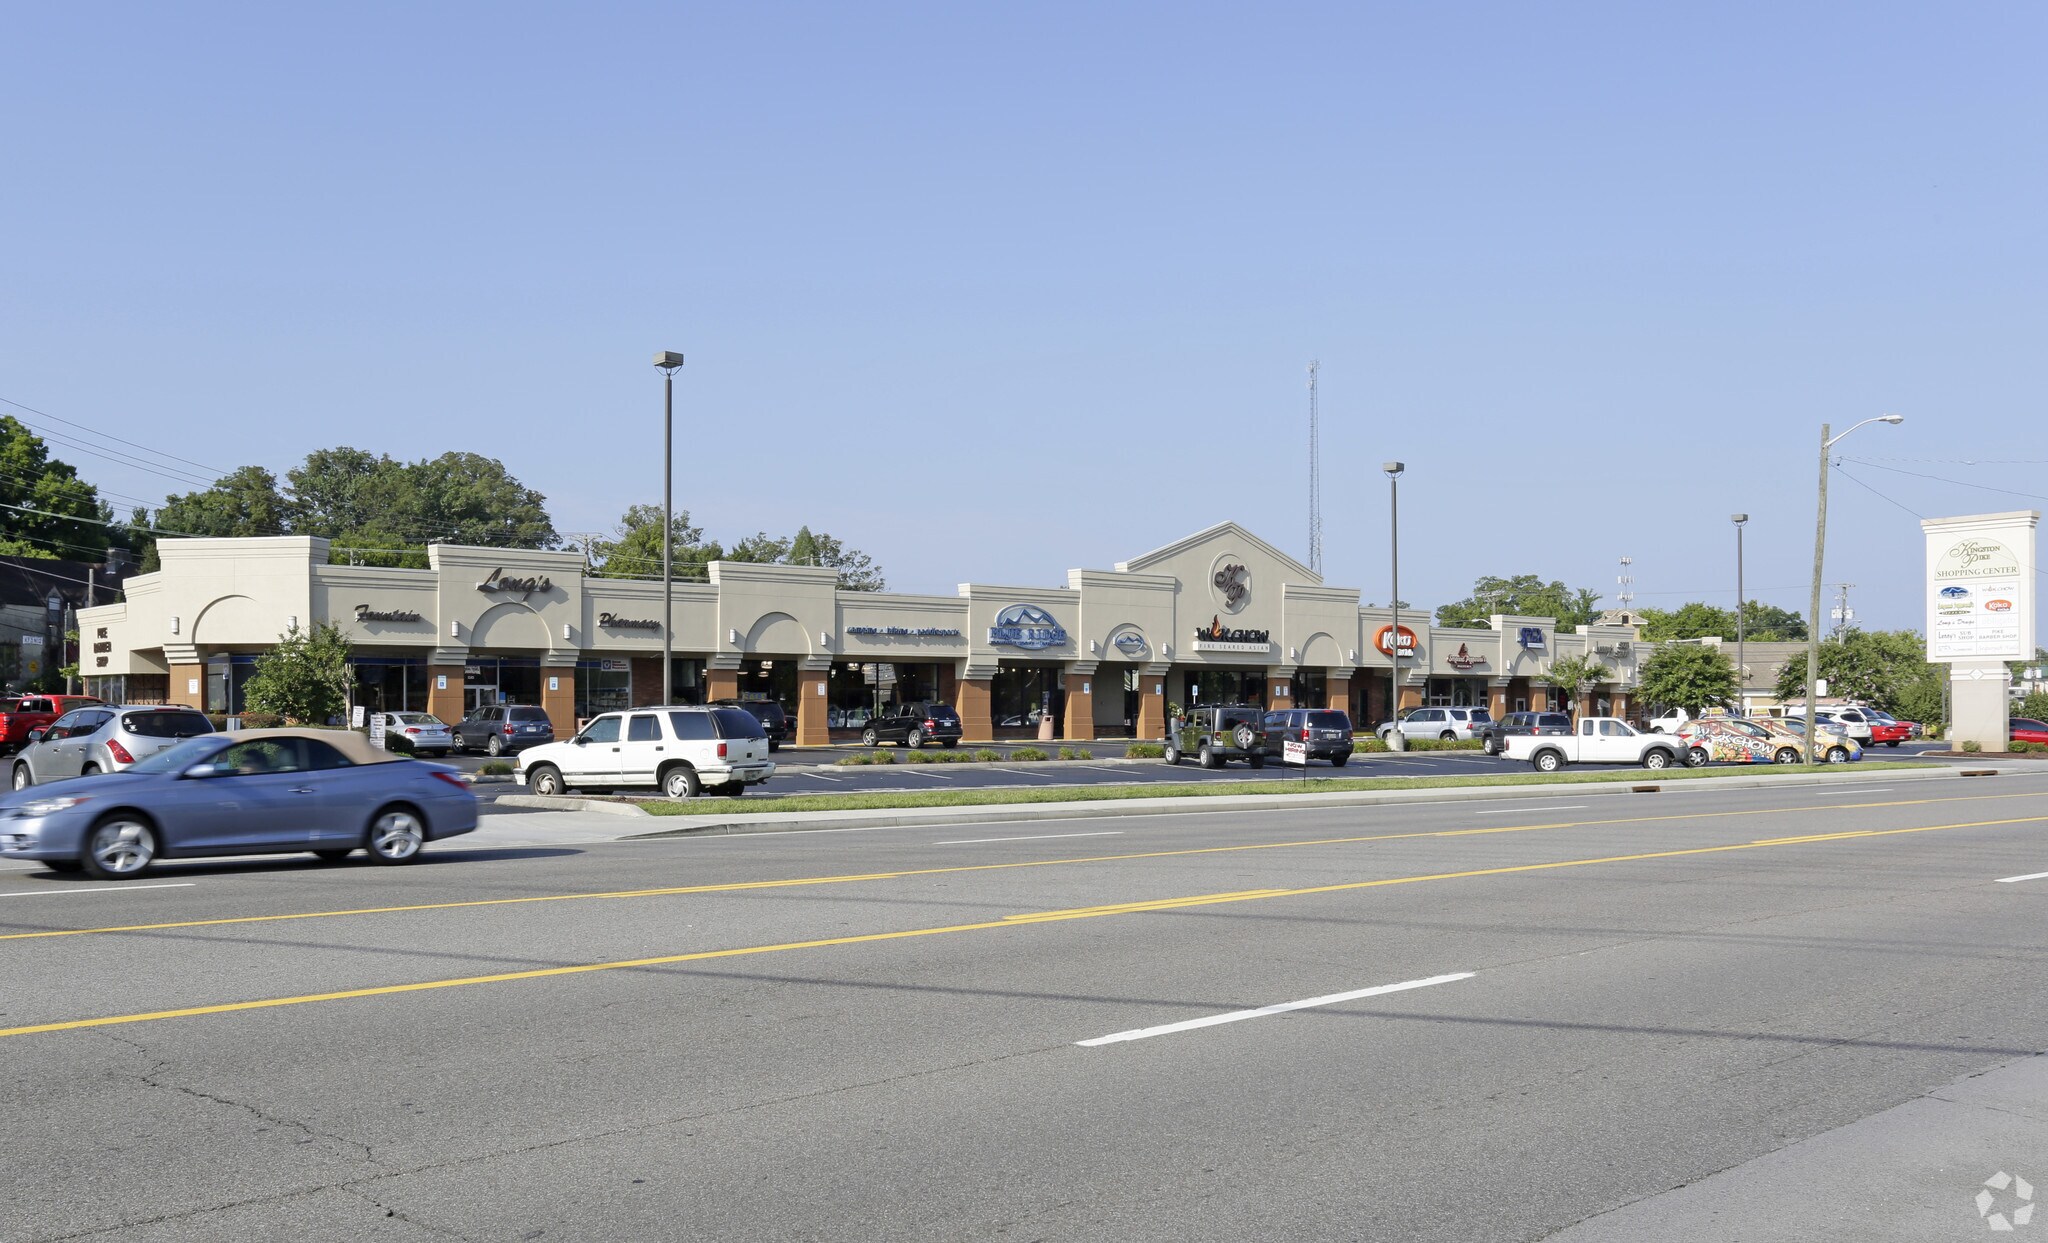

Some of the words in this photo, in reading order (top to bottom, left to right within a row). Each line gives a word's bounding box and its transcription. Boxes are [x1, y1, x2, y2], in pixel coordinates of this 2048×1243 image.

[1949, 541, 2000, 558] KINGSTON
[1961, 553, 1991, 568] PIKE
[1937, 568, 1981, 577] SHOPPING
[1983, 566, 2017, 574] CENTER
[475, 567, 553, 601] Long's
[355, 604, 420, 622] Fountain
[1988, 602, 2008, 610] Koko
[599, 612, 661, 633] Pharmacy
[991, 627, 1022, 640] BLUE
[1028, 628, 1067, 641] RIDGE
[1231, 629, 1269, 643] CHOW
[1732, 736, 1775, 754] CHOW
